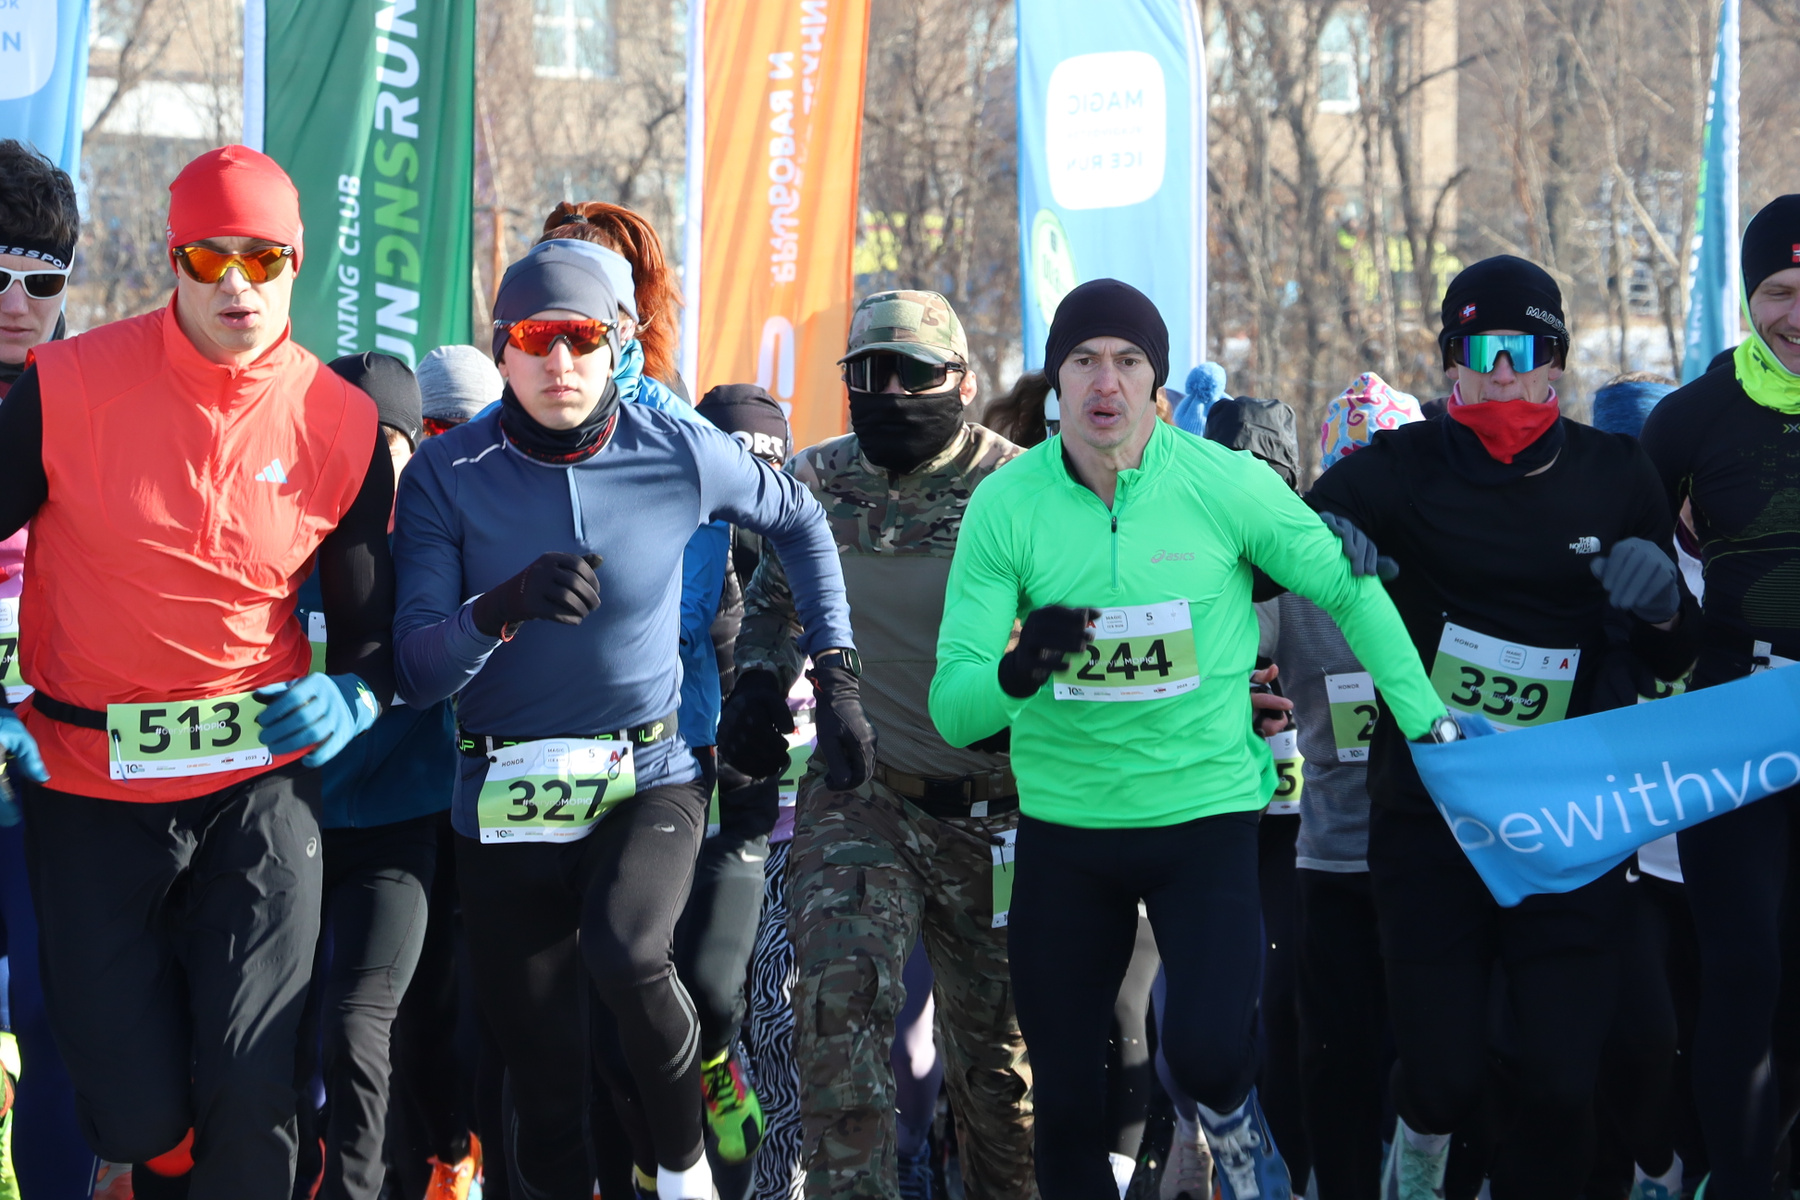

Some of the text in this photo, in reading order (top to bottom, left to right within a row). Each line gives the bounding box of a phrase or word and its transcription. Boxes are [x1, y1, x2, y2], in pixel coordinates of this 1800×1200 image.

[338, 173, 361, 257] CLUB
[1165, 552, 1195, 561] asics
[1145, 612, 1154, 621] 5
[1454, 637, 1479, 650] HONOR
[1077, 639, 1173, 682] 244
[1542, 656, 1550, 665] 5
[1559, 658, 1569, 669] A
[1451, 666, 1549, 721] 339
[139, 701, 242, 754] 513
[501, 757, 525, 767] HONOR
[609, 750, 621, 762] A
[1275, 762, 1297, 797] 5
[507, 778, 609, 822] 327
